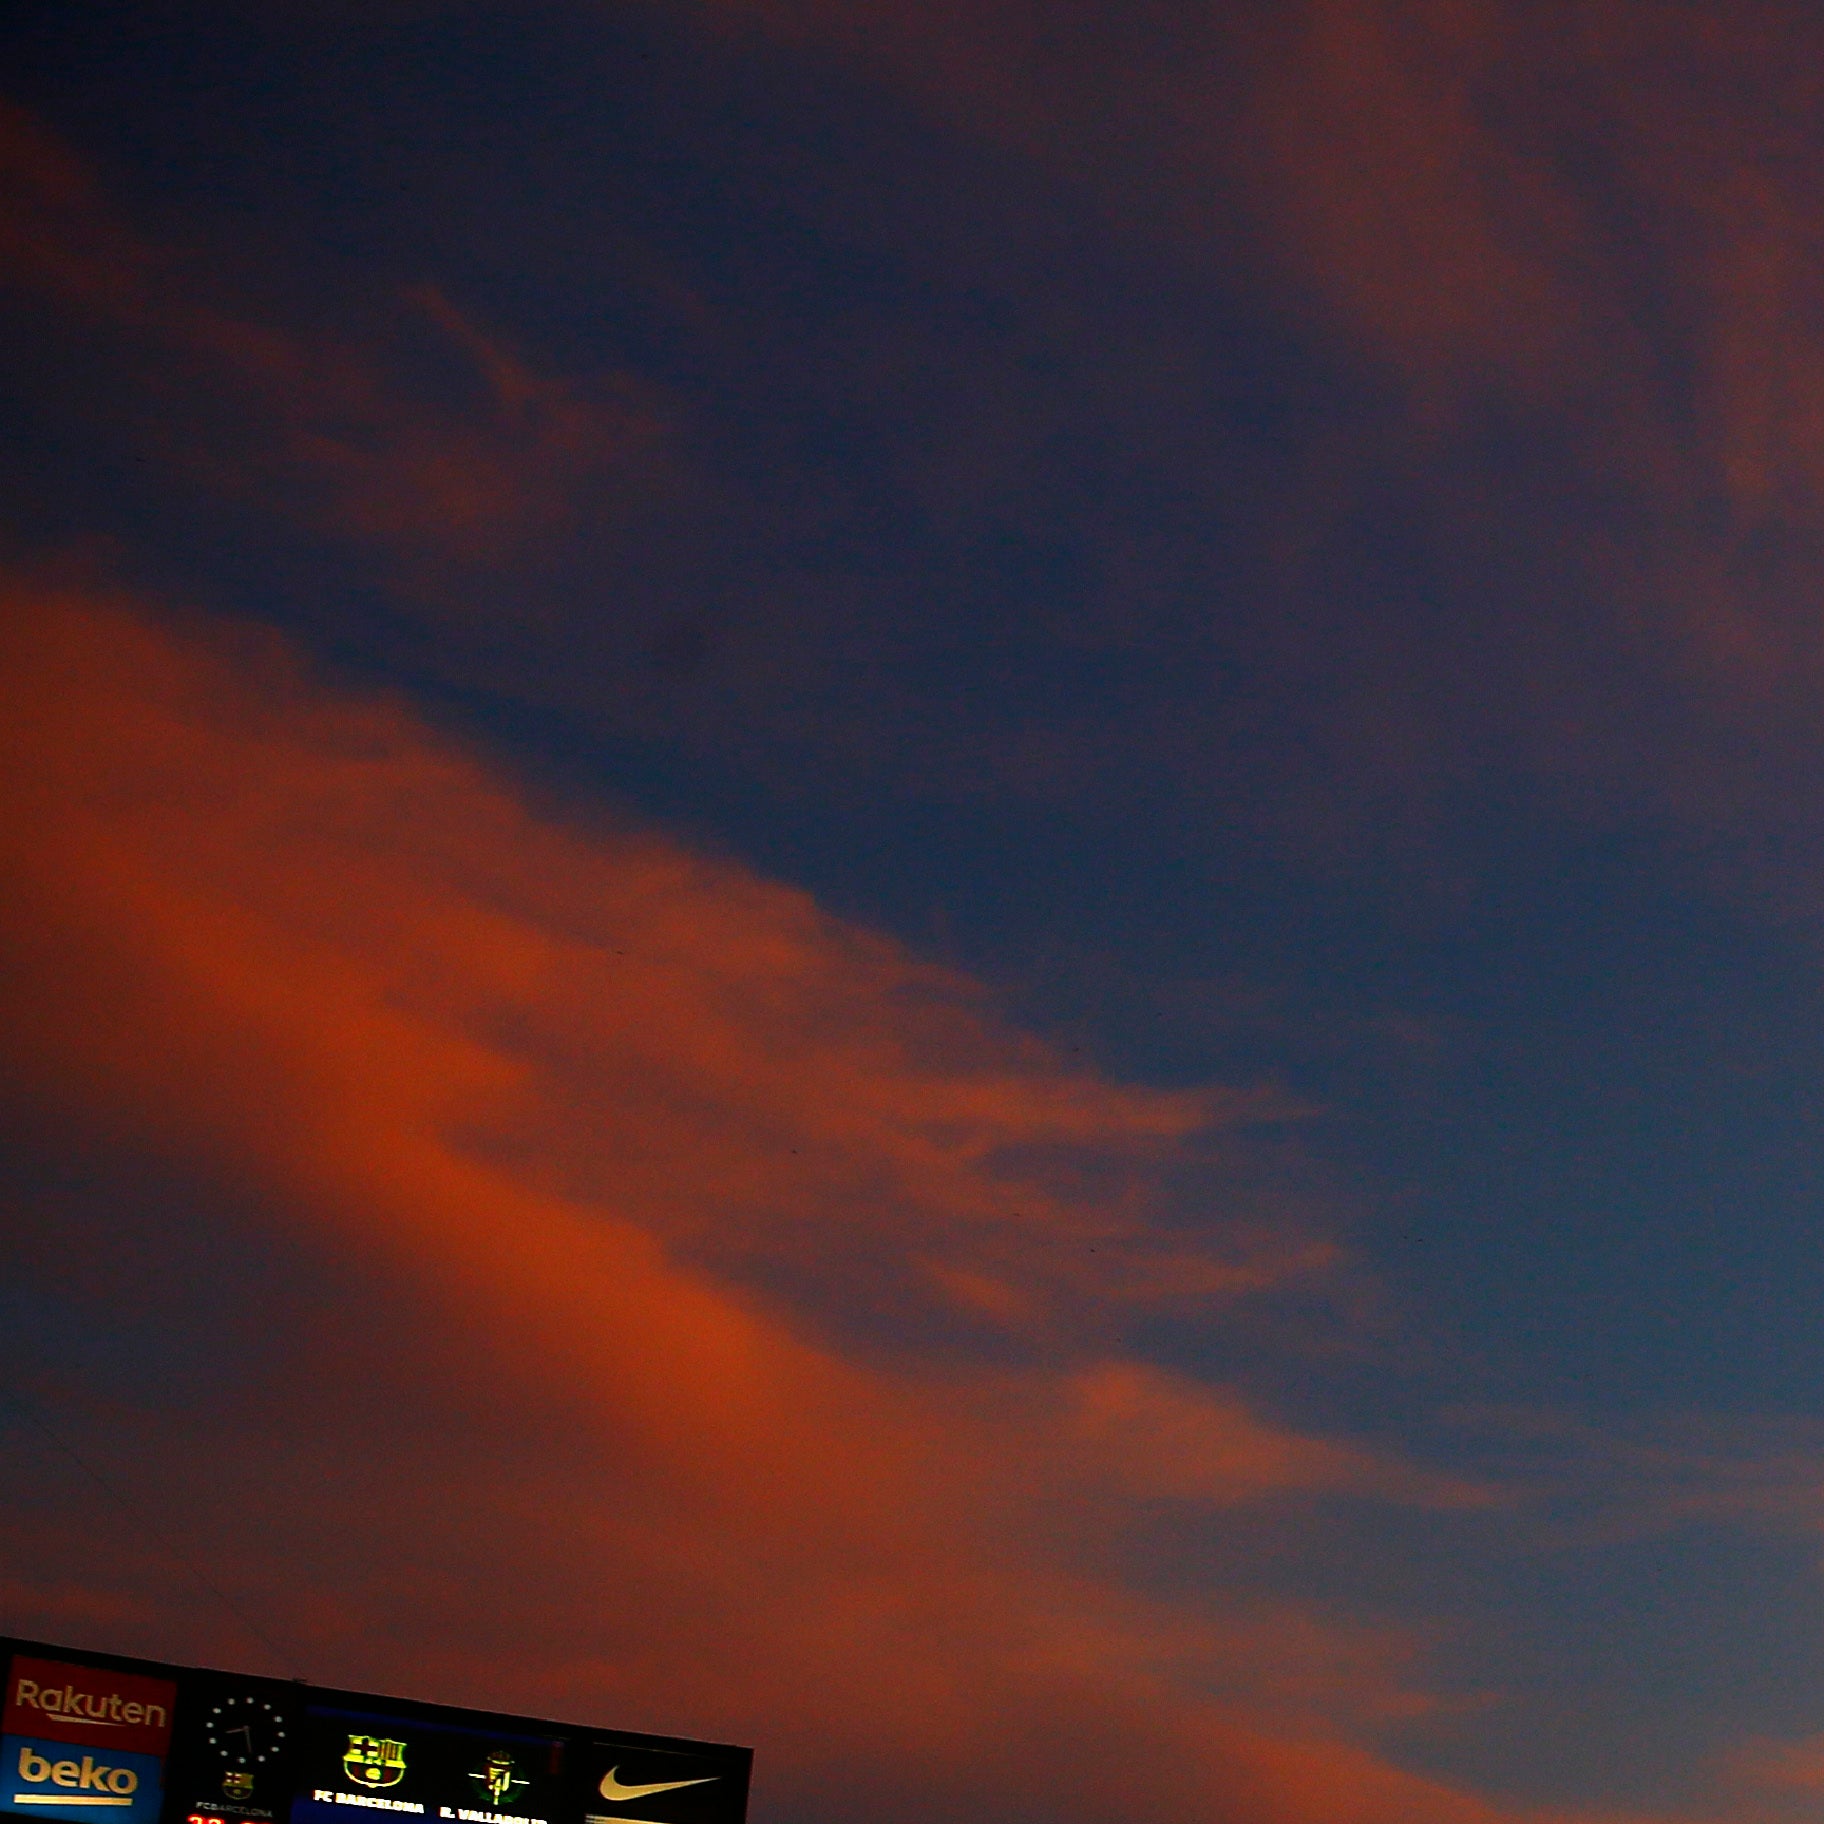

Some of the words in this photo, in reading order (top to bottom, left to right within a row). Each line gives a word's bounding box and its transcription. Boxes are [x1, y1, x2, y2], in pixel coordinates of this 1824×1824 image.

[16, 1679, 166, 1727] Rakuten
[18, 1747, 138, 1794] beko
[314, 1789, 333, 1802] FC
[335, 1792, 424, 1814] BARCELONA
